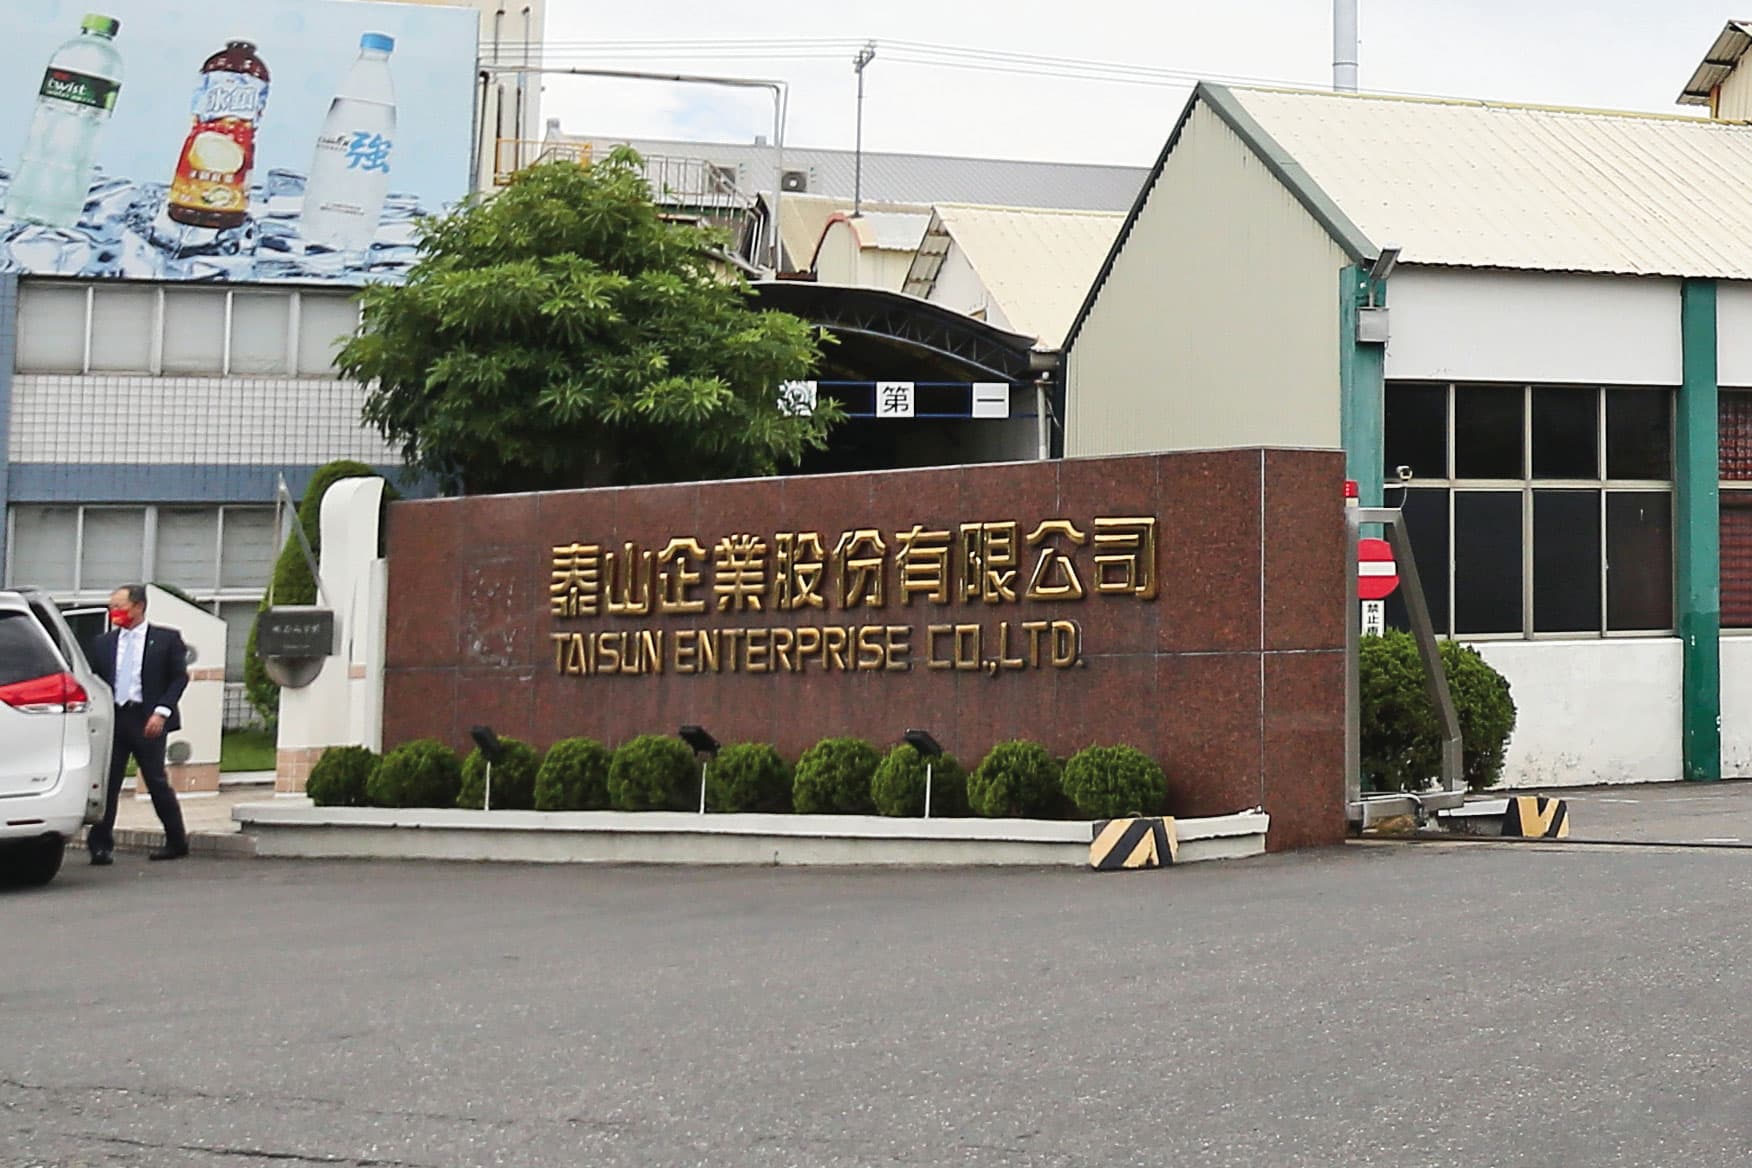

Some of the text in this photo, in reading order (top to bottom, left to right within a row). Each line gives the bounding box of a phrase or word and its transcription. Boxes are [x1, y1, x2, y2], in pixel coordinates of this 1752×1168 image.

[549, 517, 1156, 617] 泰山企業股份有限公司
[551, 629, 664, 675] TAISUN
[672, 625, 911, 673] ENTERPRISE
